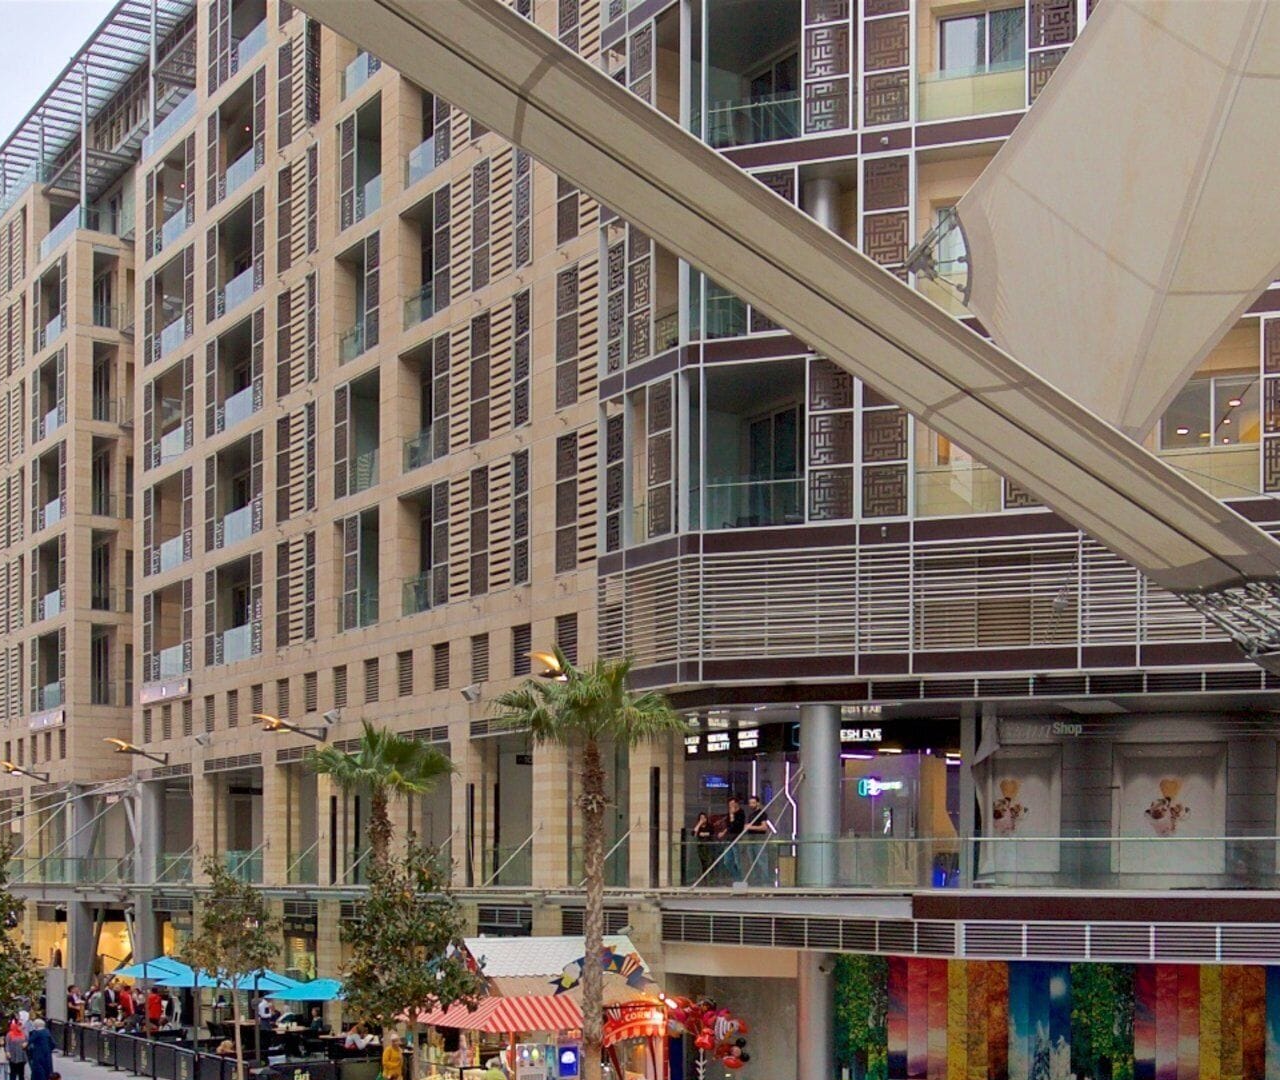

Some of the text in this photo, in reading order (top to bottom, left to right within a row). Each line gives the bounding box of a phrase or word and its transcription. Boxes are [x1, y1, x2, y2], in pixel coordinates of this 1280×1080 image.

[840, 728, 882, 741] ESH EYE
[1053, 721, 1082, 737] Shop
